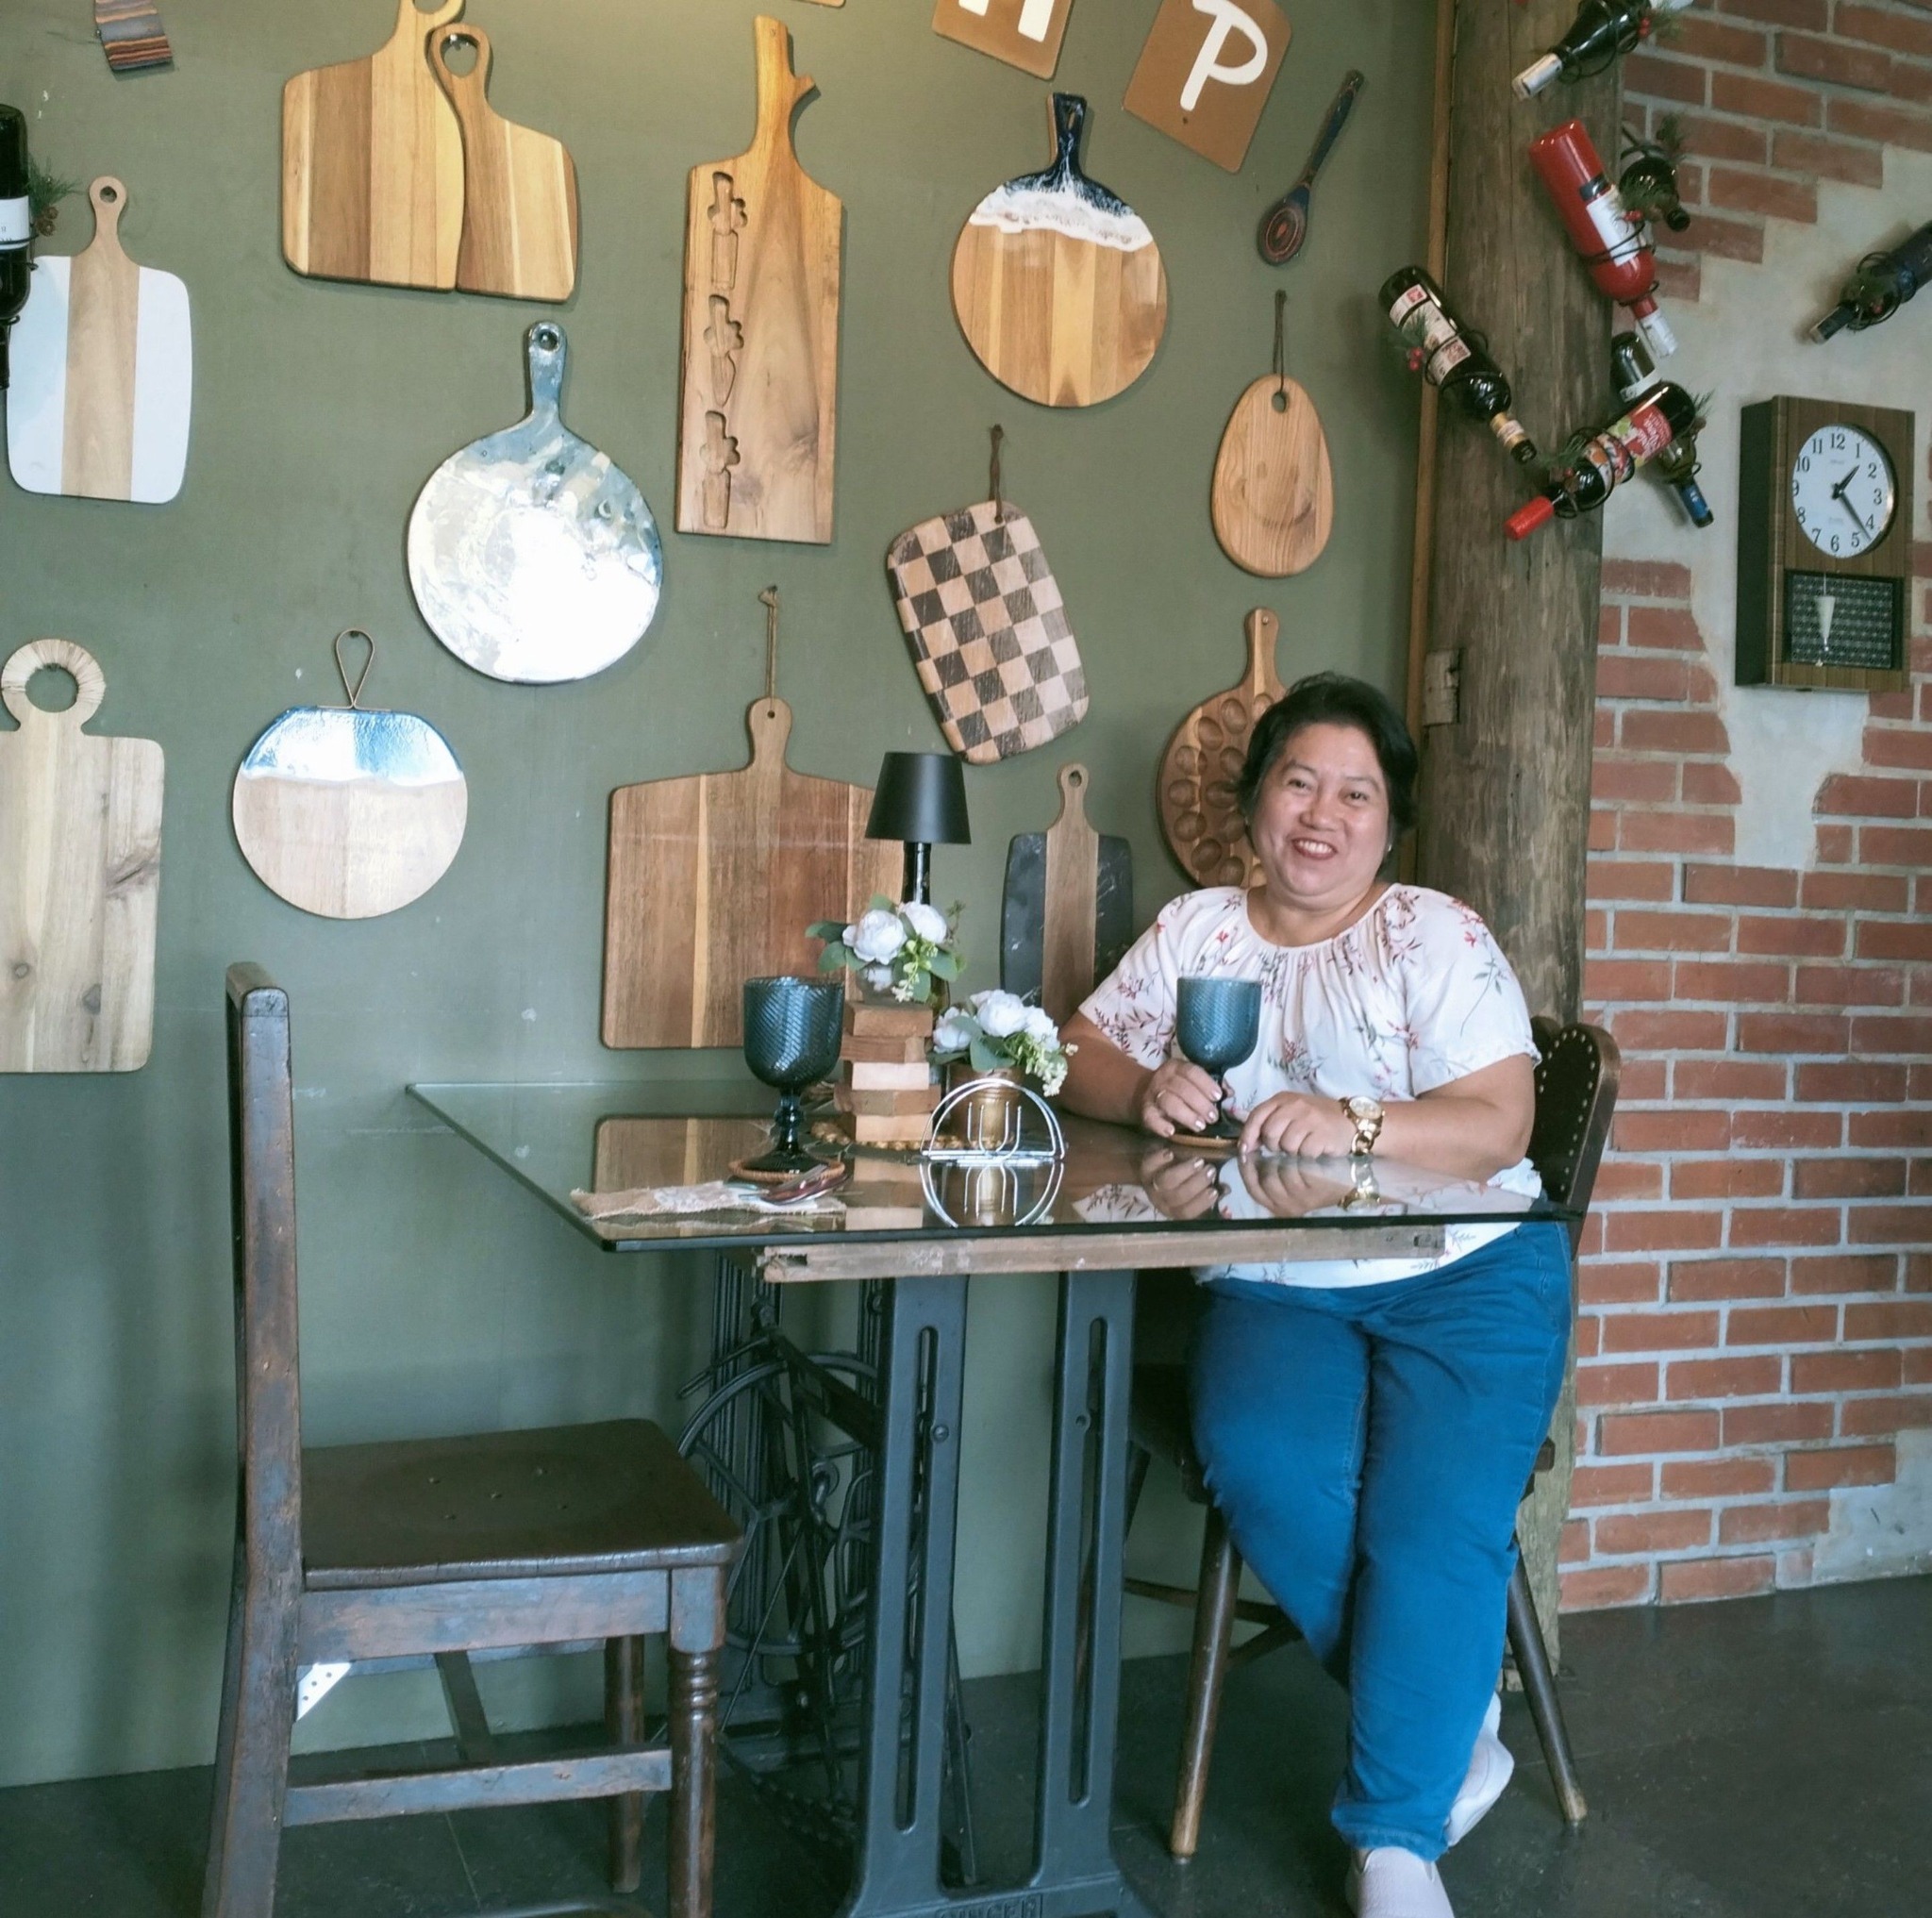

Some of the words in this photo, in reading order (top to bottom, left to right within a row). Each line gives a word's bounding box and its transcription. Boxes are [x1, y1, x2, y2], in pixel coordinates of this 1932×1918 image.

[1179, 0, 1268, 111] P
[1812, 438, 1823, 454] 11
[1830, 433, 1845, 450] 12
[1856, 442, 1860, 459] 1
[1796, 456, 1810, 473] 10
[1868, 462, 1877, 479] 2
[1792, 479, 1800, 497] 9
[1874, 488, 1882, 505] 3
[1797, 507, 1806, 525] 8
[1865, 514, 1874, 529] 4
[1812, 528, 1822, 544] 7
[1830, 534, 1840, 552] 6
[1851, 531, 1860, 547] 5
